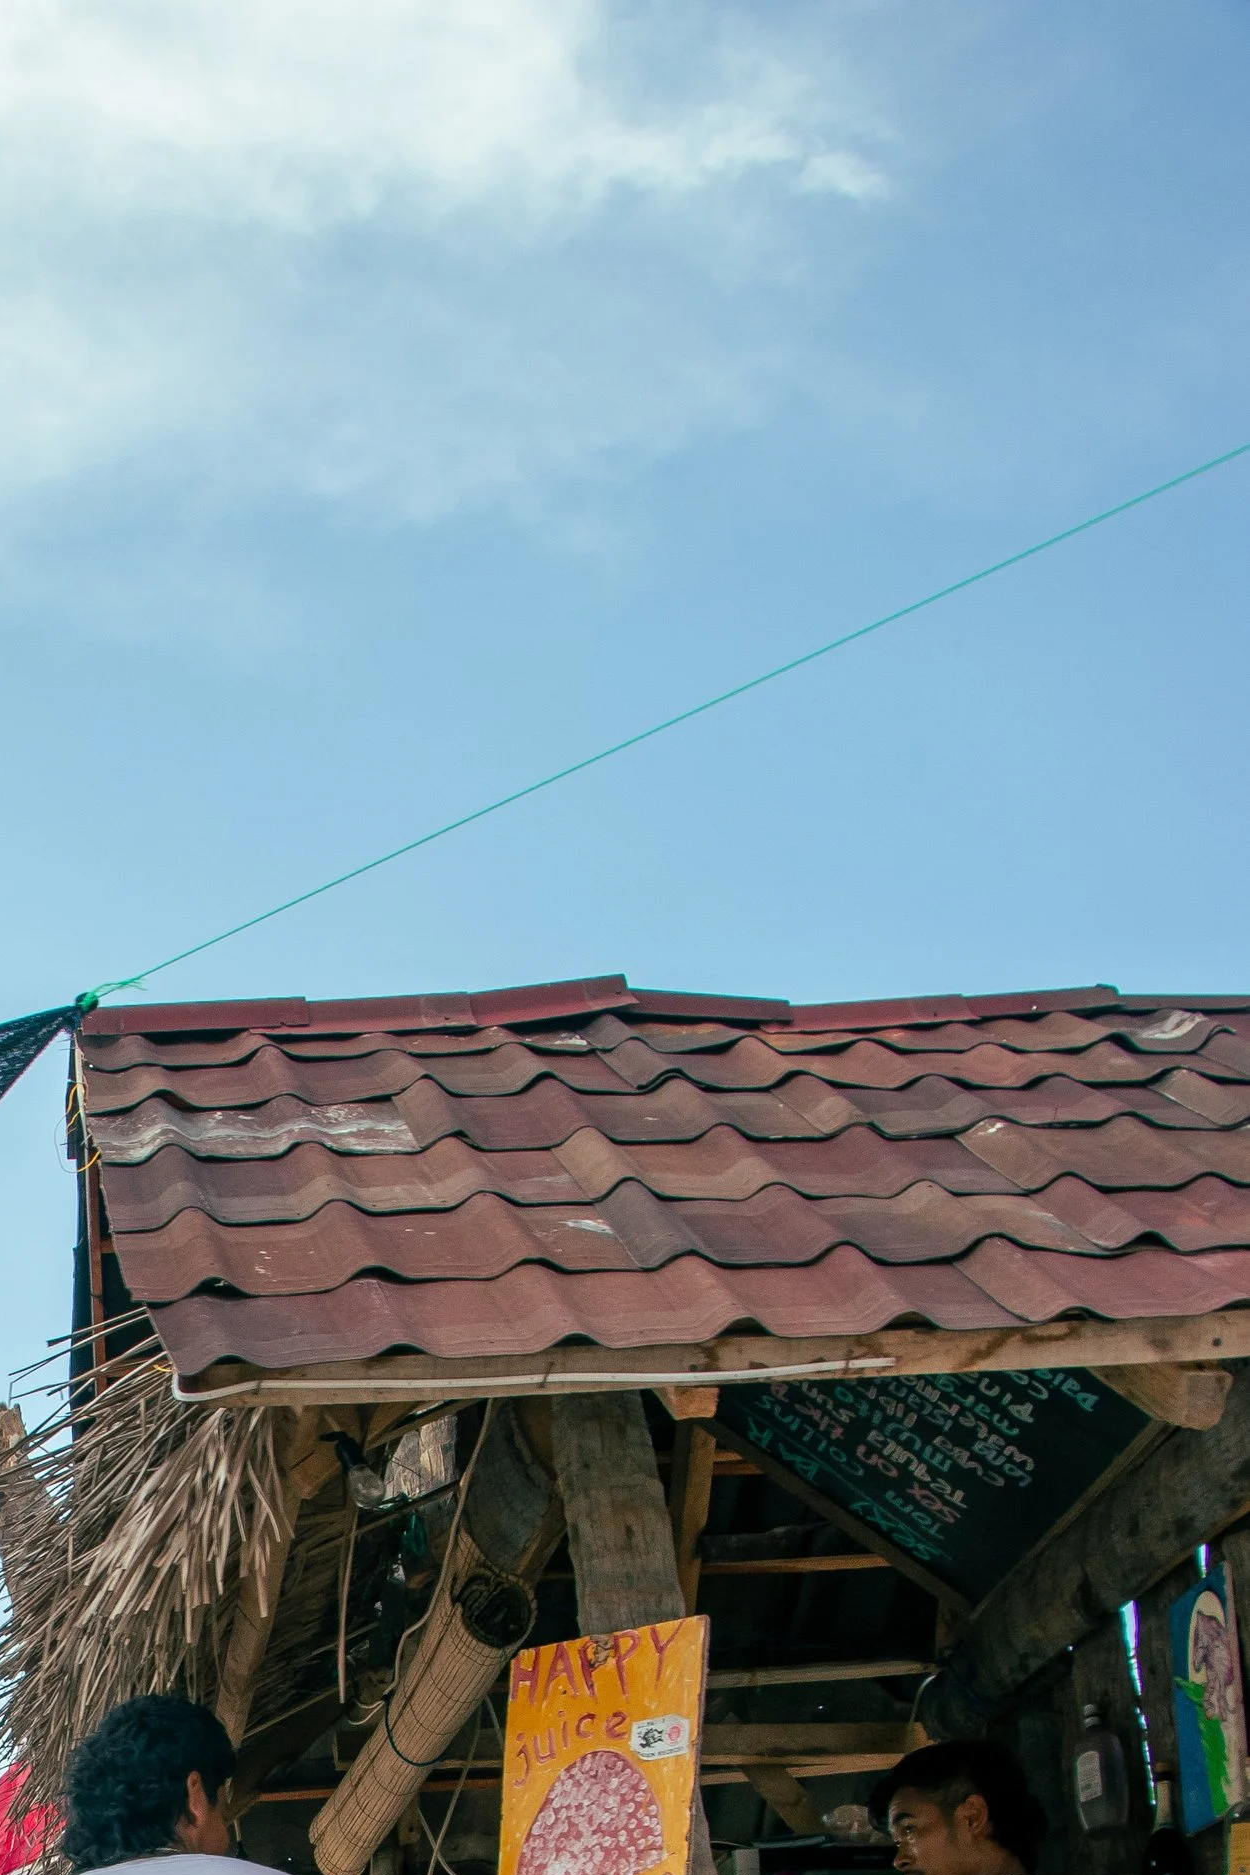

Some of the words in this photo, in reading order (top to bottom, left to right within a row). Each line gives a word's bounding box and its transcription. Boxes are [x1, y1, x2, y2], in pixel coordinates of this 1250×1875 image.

[749, 1418, 830, 1480] BAR
[857, 1445, 898, 1476] on
[510, 1618, 687, 1705] HAPPY
[513, 1709, 630, 1788] juice
